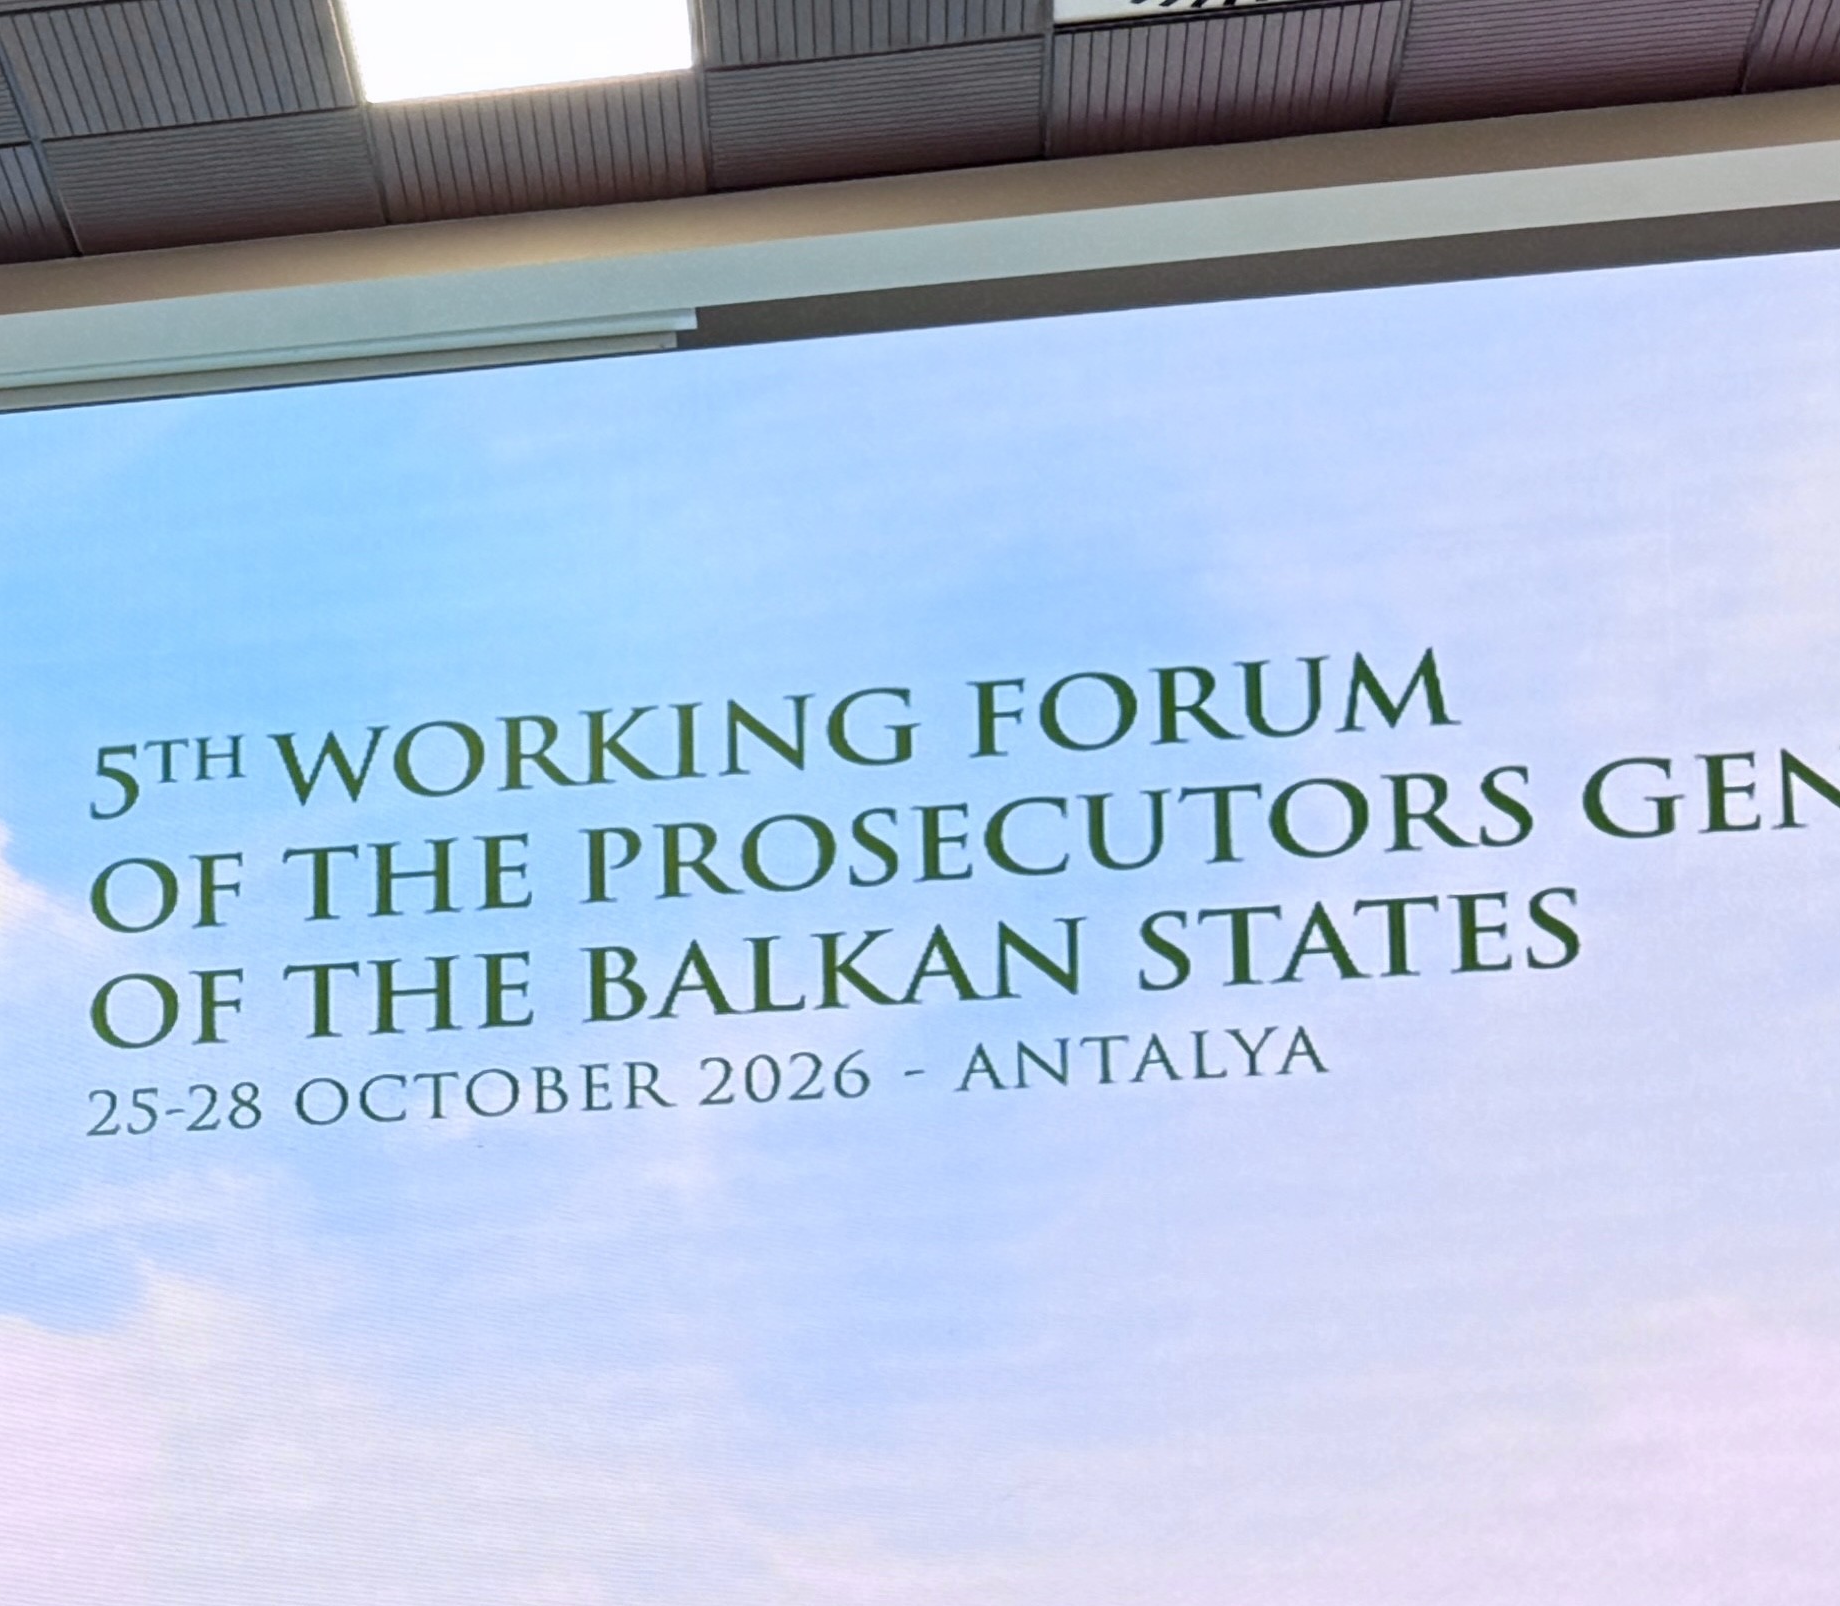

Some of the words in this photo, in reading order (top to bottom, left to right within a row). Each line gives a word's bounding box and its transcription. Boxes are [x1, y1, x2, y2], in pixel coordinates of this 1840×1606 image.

[269, 687, 917, 806] WORKING
[973, 647, 1457, 757] FORUM
[90, 852, 243, 934] OF
[283, 833, 532, 921] THE
[586, 765, 1534, 903] PROSECUTORS
[1582, 748, 1840, 839] GEN
[90, 968, 243, 1049] OF
[283, 951, 534, 1038] THE
[586, 917, 1083, 1022] BALKAN
[1139, 887, 1581, 991] STATES
[88, 1082, 262, 1137] 25-28
[295, 1062, 672, 1125] OCTOBER
[700, 1050, 870, 1105] 2026
[959, 1026, 1328, 1092] ANTALYA
